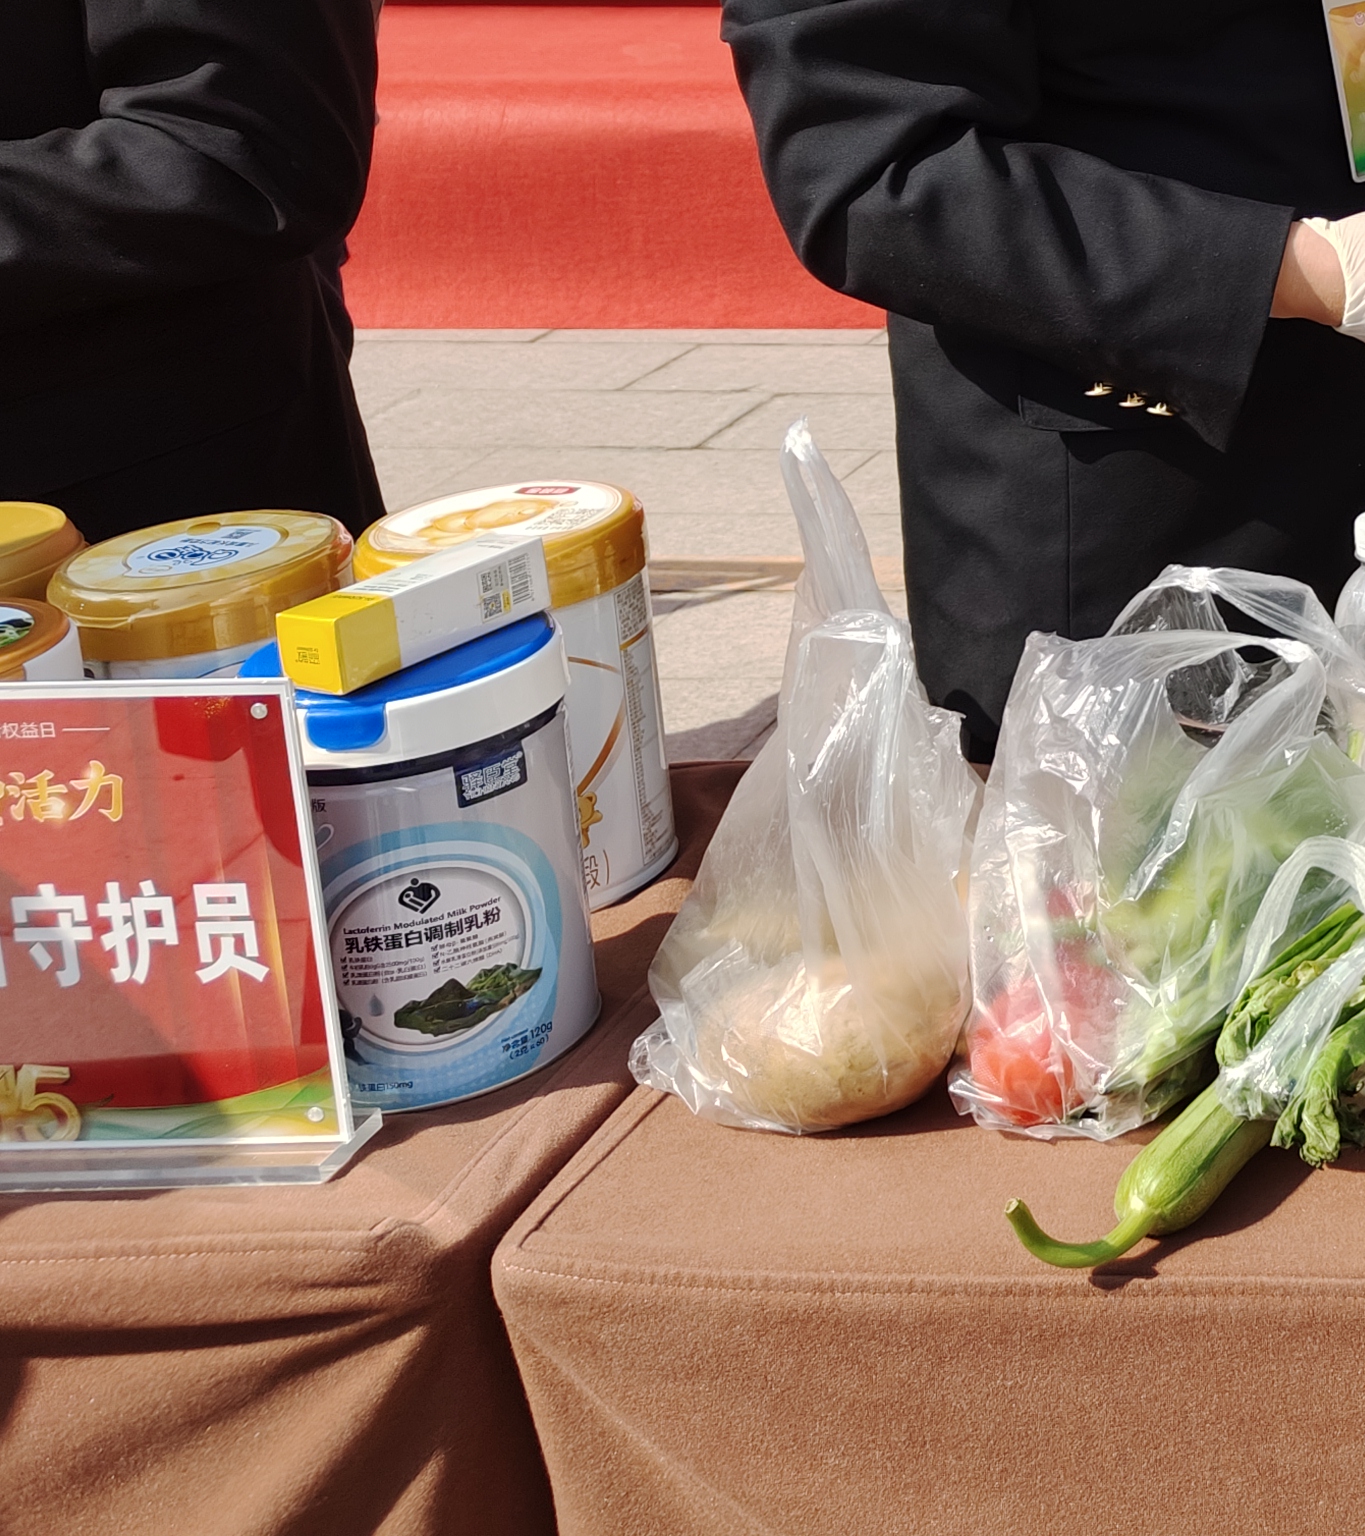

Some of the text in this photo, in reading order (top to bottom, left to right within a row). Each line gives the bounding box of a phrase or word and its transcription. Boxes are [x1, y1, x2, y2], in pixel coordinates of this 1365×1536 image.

[344, 906, 502, 954] 乳铁蛋白调制乳粉
[393, 913, 445, 931] Modulated
[447, 907, 468, 919] Milk
[469, 895, 502, 913] Powder
